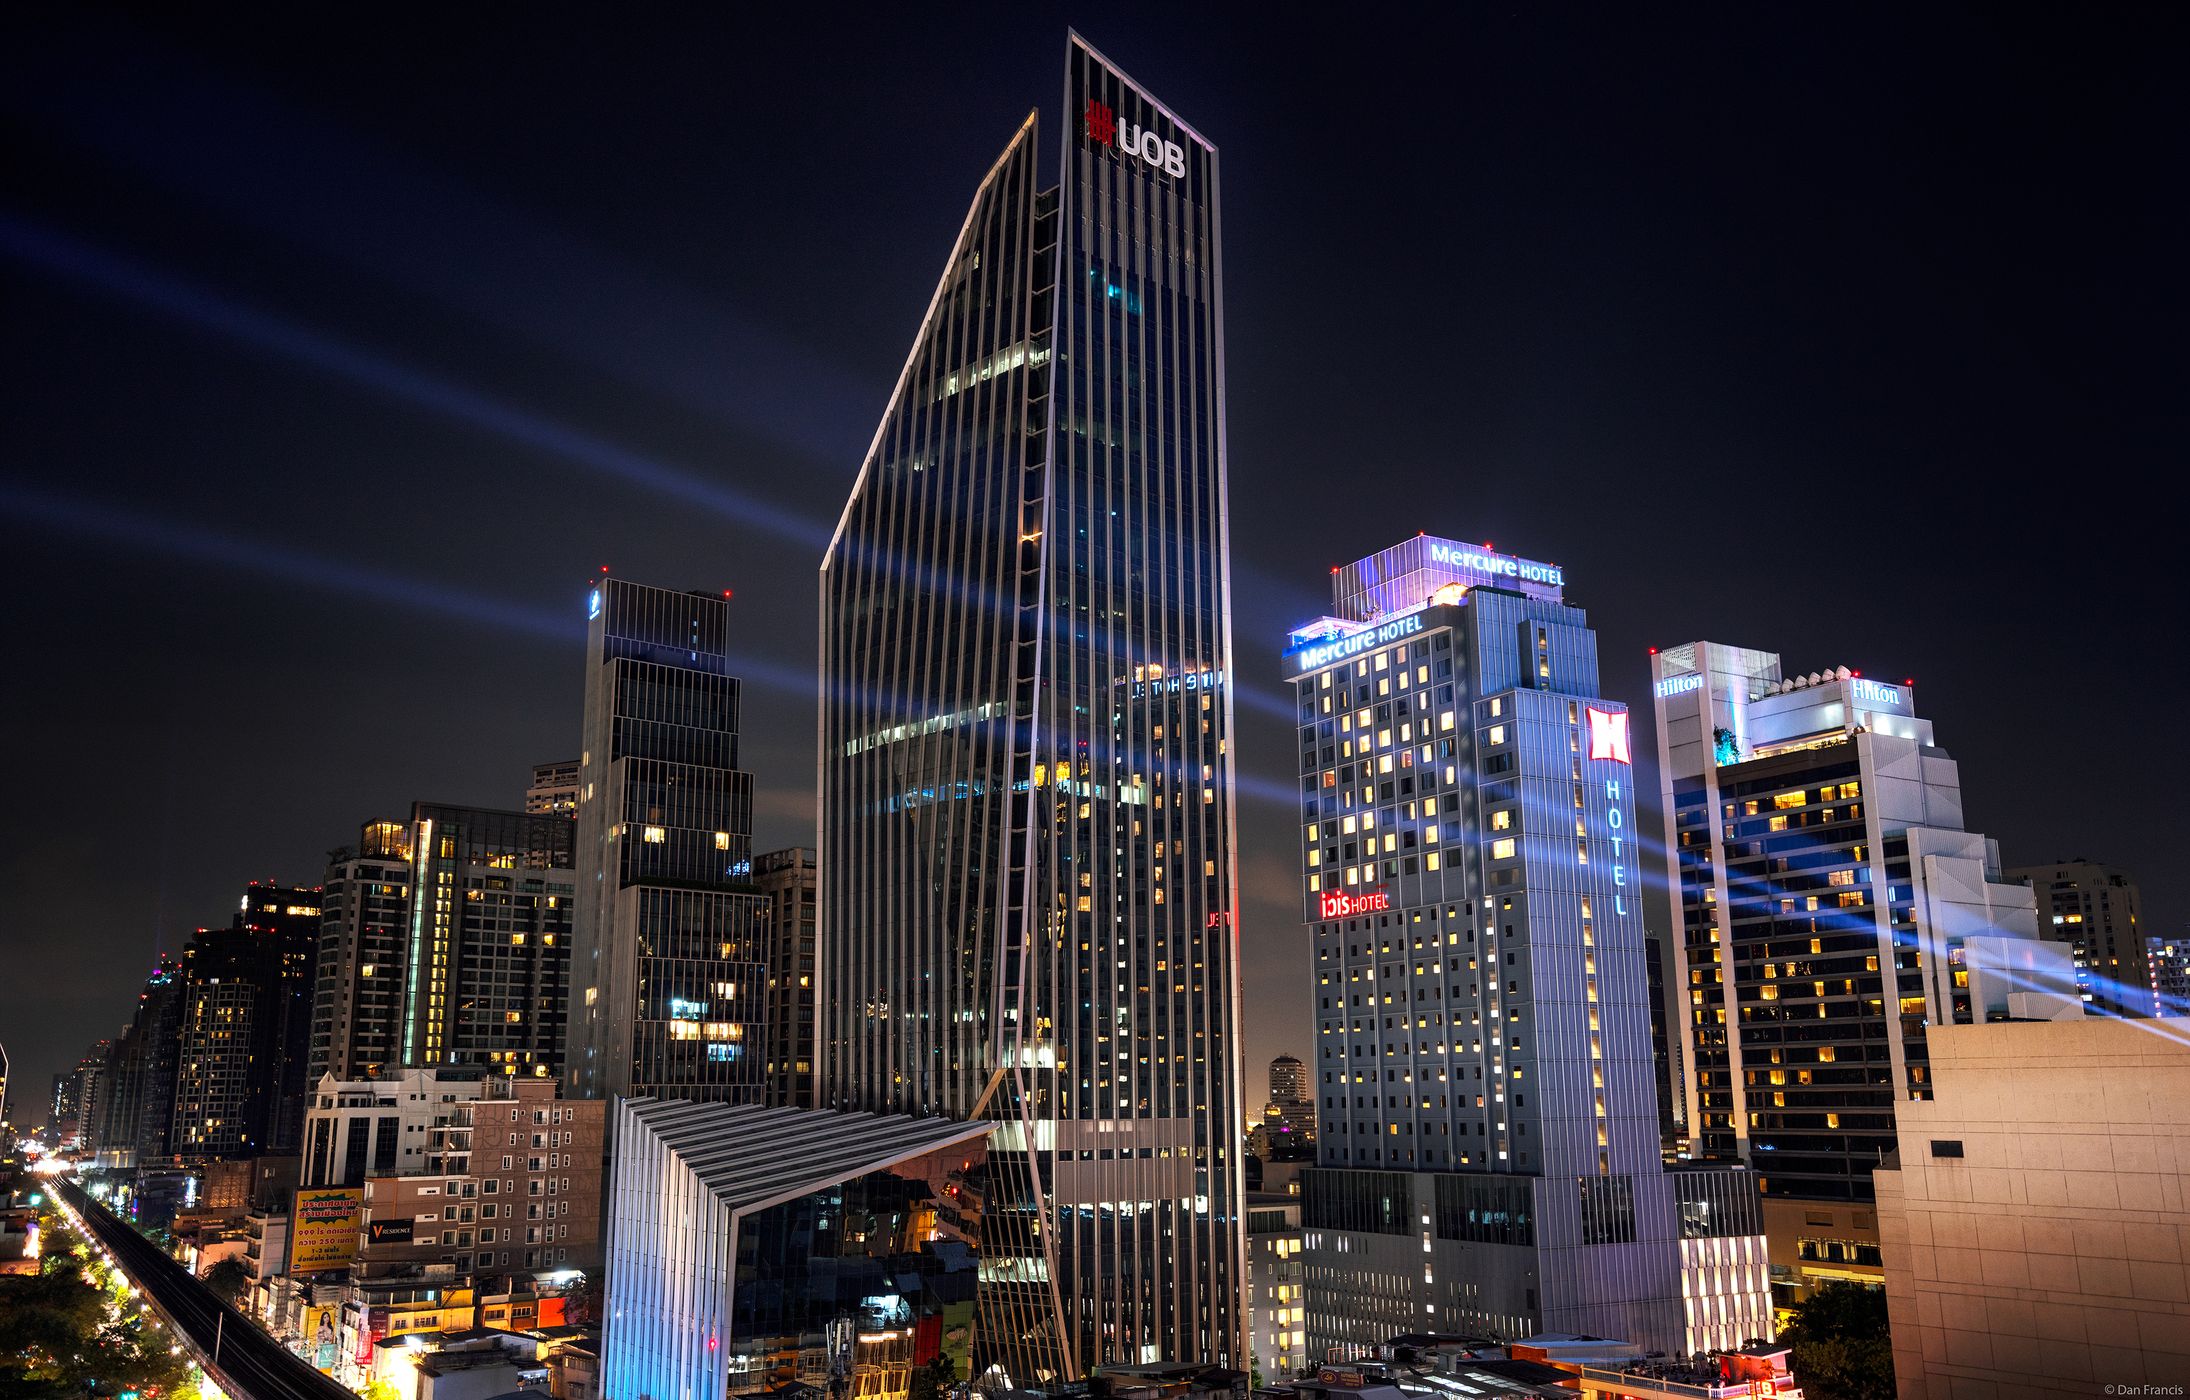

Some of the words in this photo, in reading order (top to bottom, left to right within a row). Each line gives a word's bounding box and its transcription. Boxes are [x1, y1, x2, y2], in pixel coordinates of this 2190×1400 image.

[1118, 117, 1186, 179] UOB
[1431, 543, 1518, 577] Mercure
[1520, 564, 1565, 586] HOTEL
[1300, 630, 1376, 670] Mercure
[1378, 615, 1423, 643] HOTEL
[1656, 674, 1703, 698] Hilton
[1851, 678, 1900, 705] Hilton
[1606, 779, 1627, 915] HOTEL
[1351, 893, 1389, 913] HOTEL
[373, 1225, 383, 1239] V
